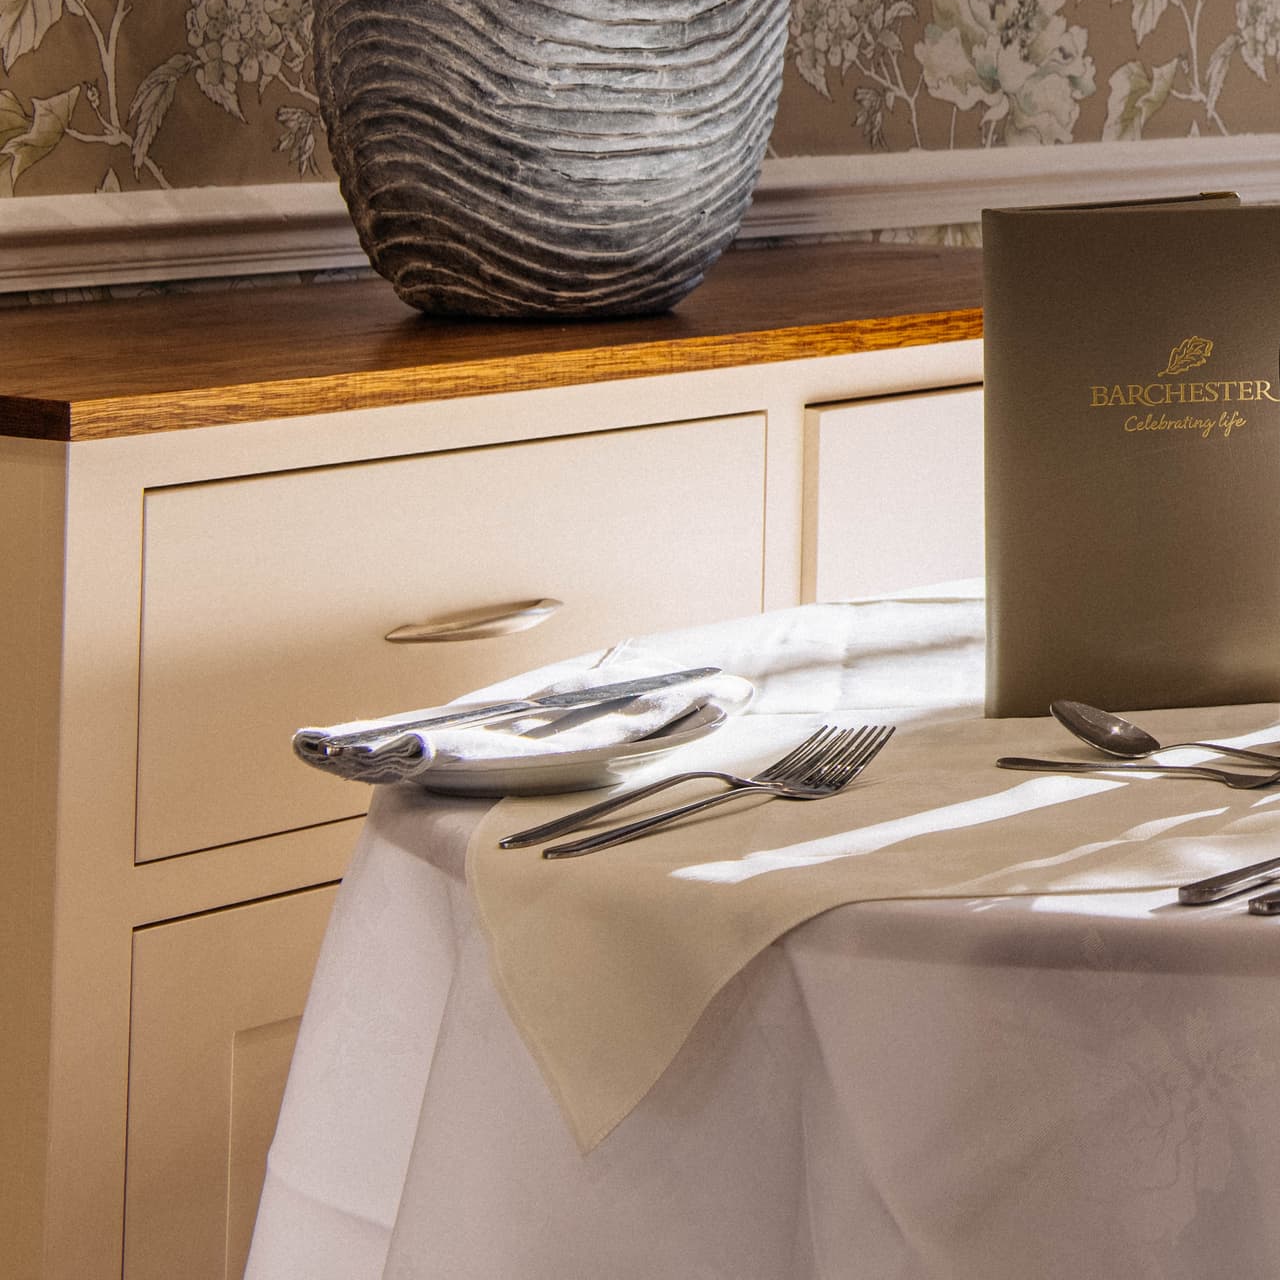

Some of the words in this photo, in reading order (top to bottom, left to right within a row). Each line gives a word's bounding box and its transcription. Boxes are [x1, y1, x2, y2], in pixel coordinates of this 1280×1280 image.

[1090, 380, 1280, 407] BARCHESTER
[1124, 413, 1216, 438] Celebrating
[1218, 411, 1247, 437] life
